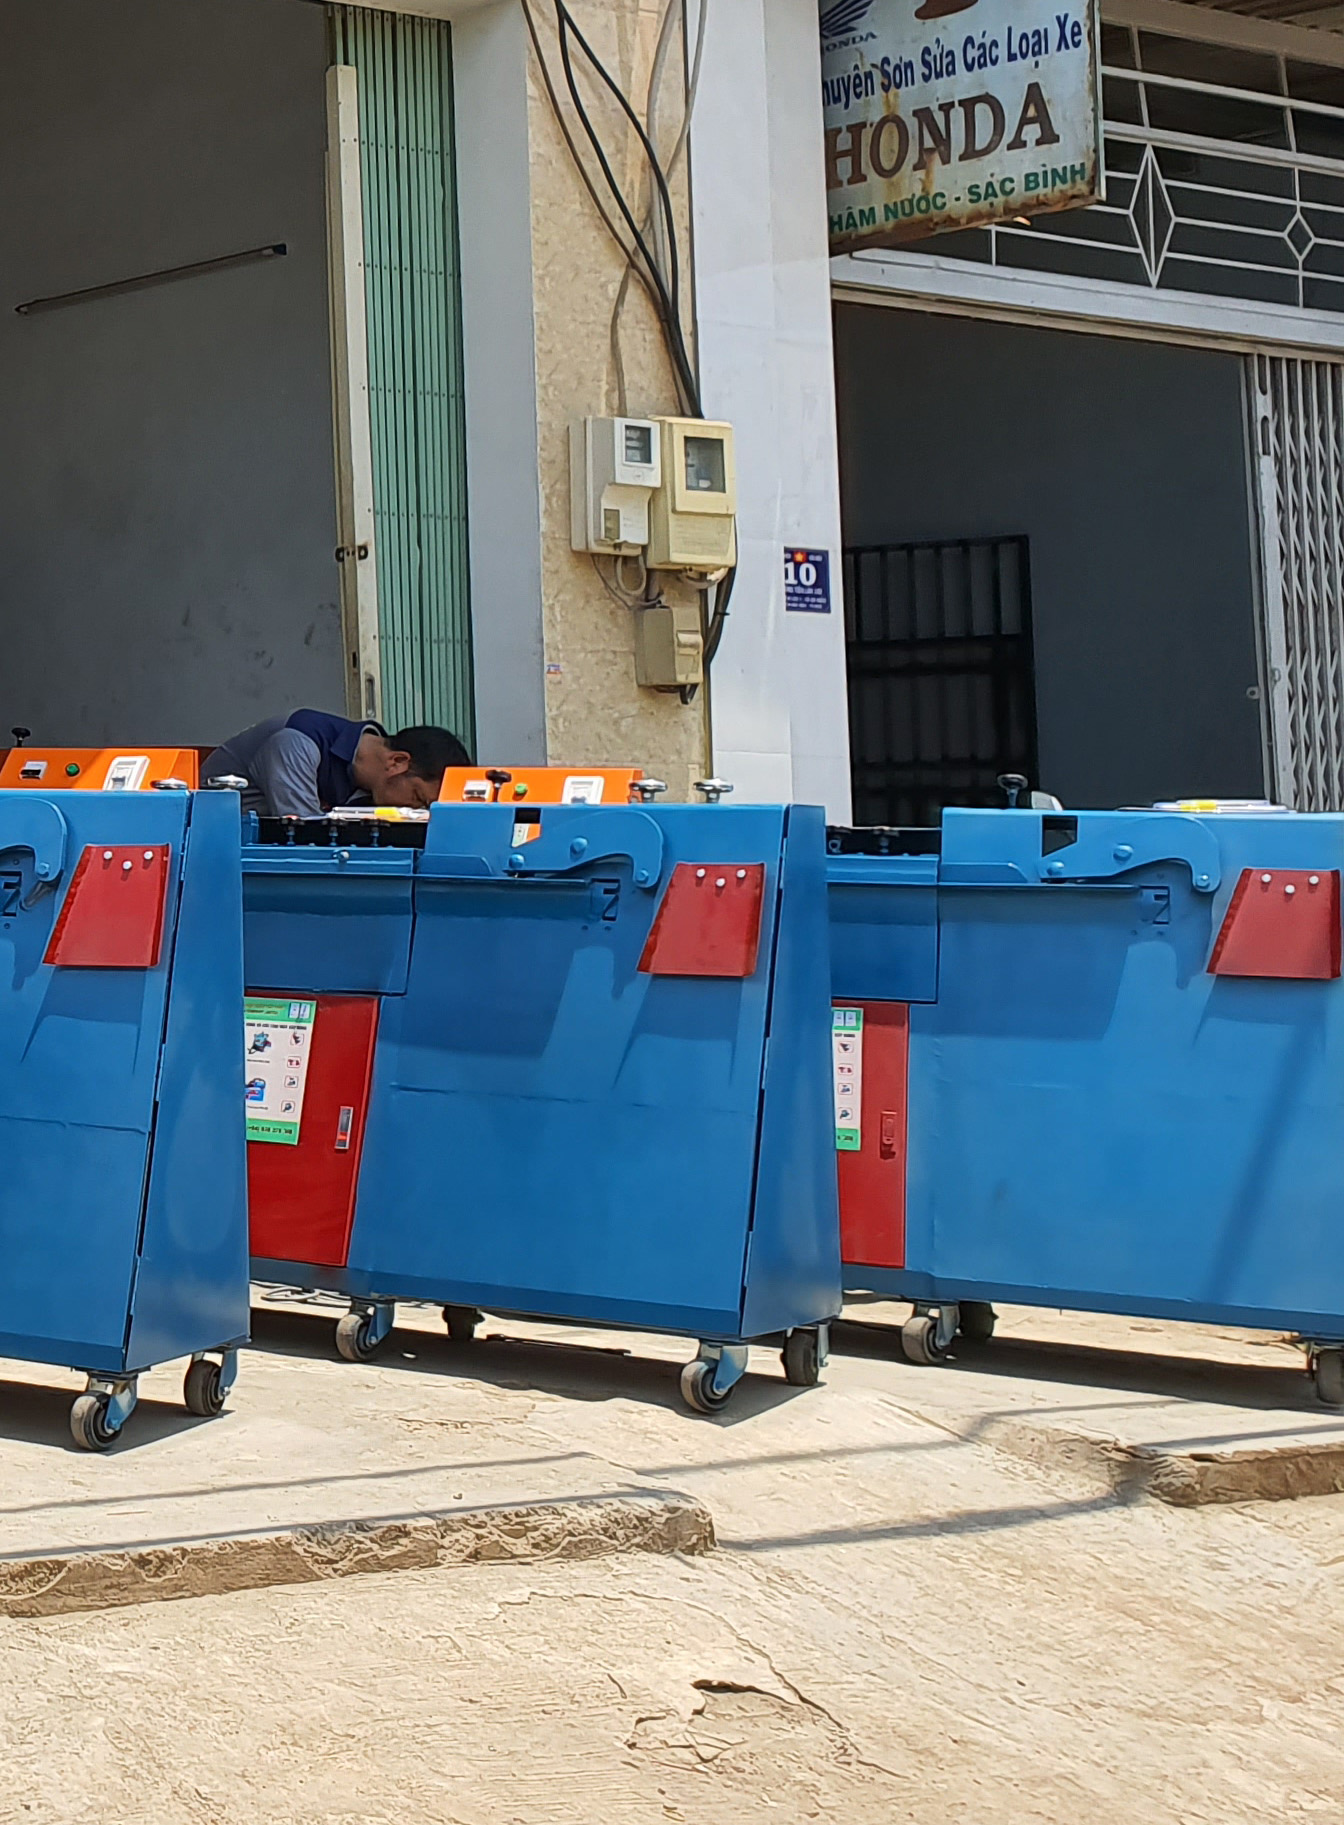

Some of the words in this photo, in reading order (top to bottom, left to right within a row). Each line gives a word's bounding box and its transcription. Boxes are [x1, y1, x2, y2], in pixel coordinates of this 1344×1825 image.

[822, 63, 875, 111] huyên
[880, 56, 915, 94] Sơn
[920, 37, 957, 84] Sửa
[962, 30, 1000, 73] Các
[1006, 25, 1050, 69] Loại
[1055, 12, 1082, 53] Xe
[825, 31, 878, 53] ONDA
[823, 81, 1061, 190] HONDA
[829, 206, 876, 234] HÂM
[967, 177, 1015, 208] SẠC
[1024, 162, 1085, 192] BÌNH
[785, 561, 817, 587] 10
